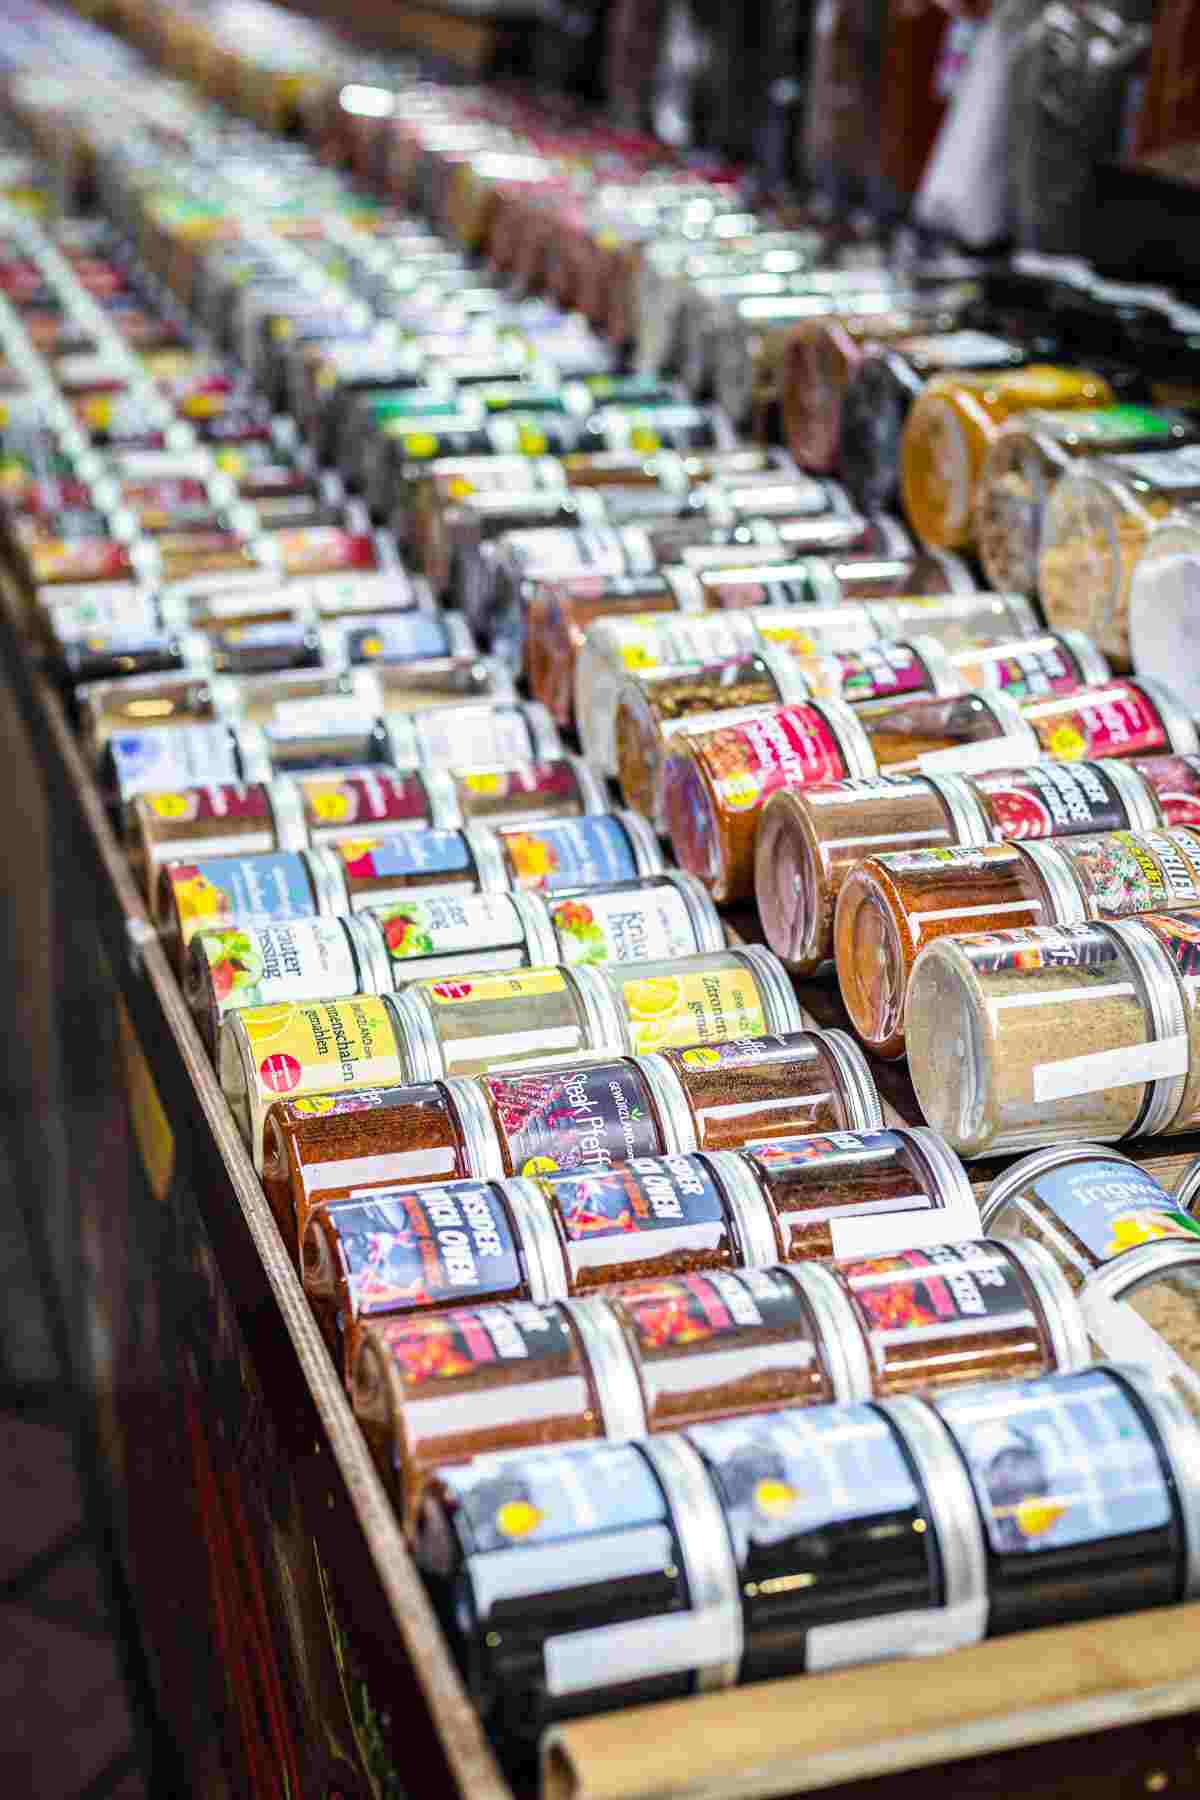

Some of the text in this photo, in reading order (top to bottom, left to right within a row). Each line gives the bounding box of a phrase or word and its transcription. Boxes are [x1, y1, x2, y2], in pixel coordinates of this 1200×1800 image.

[559, 1072, 597, 1113] Steak
[643, 1175, 684, 1218] OVEN
[437, 1230, 480, 1285] OVEN
